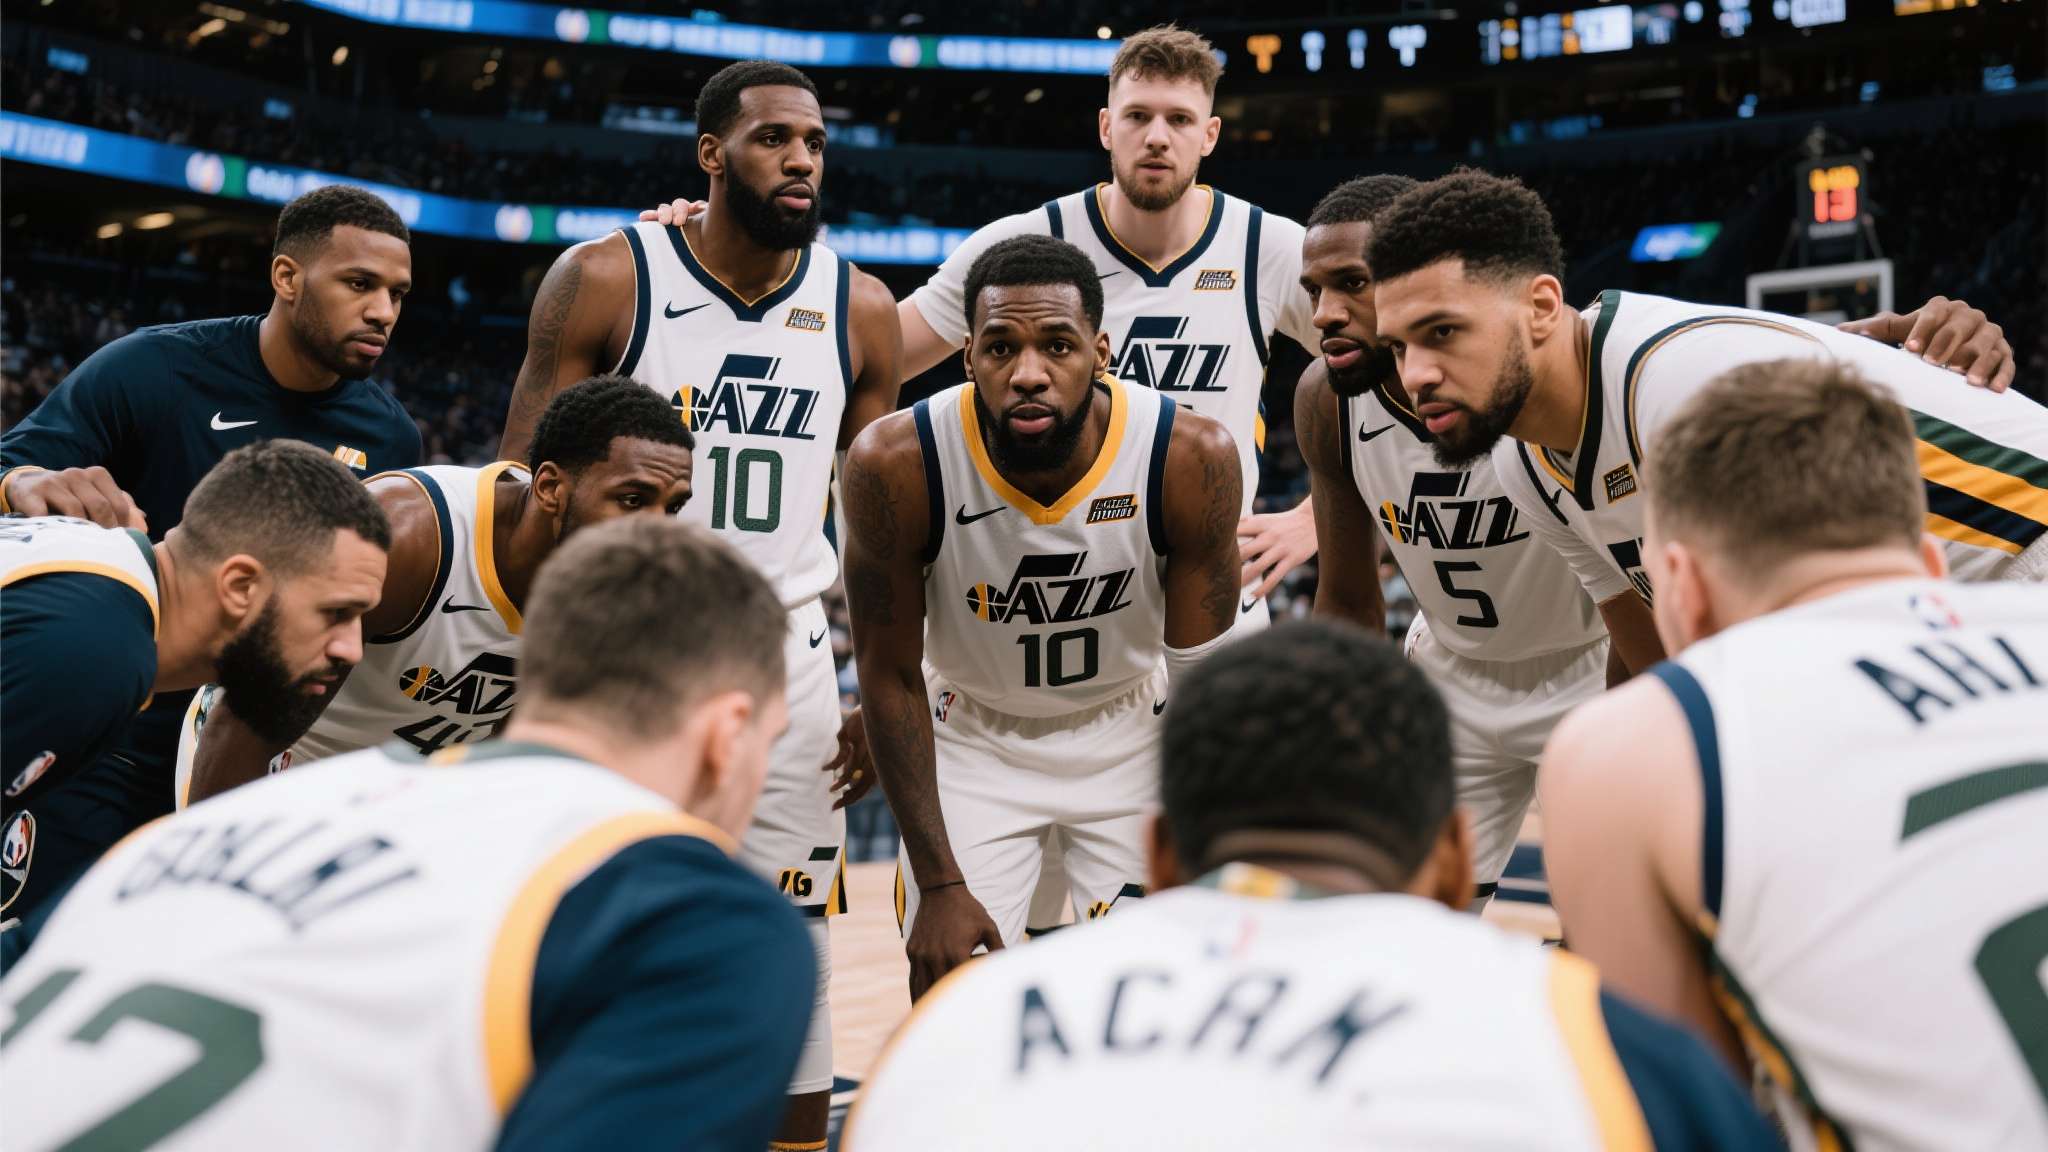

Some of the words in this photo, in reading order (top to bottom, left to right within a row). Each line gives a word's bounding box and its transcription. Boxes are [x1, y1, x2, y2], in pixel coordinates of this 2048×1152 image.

[671, 354, 820, 441] JAZZ
[707, 446, 783, 533] 10
[1380, 471, 1530, 550] JAZZ
[966, 551, 1136, 624] JAZZ
[1433, 561, 1499, 628] 5
[399, 652, 518, 715] JAZ
[1016, 628, 1099, 687] 10
